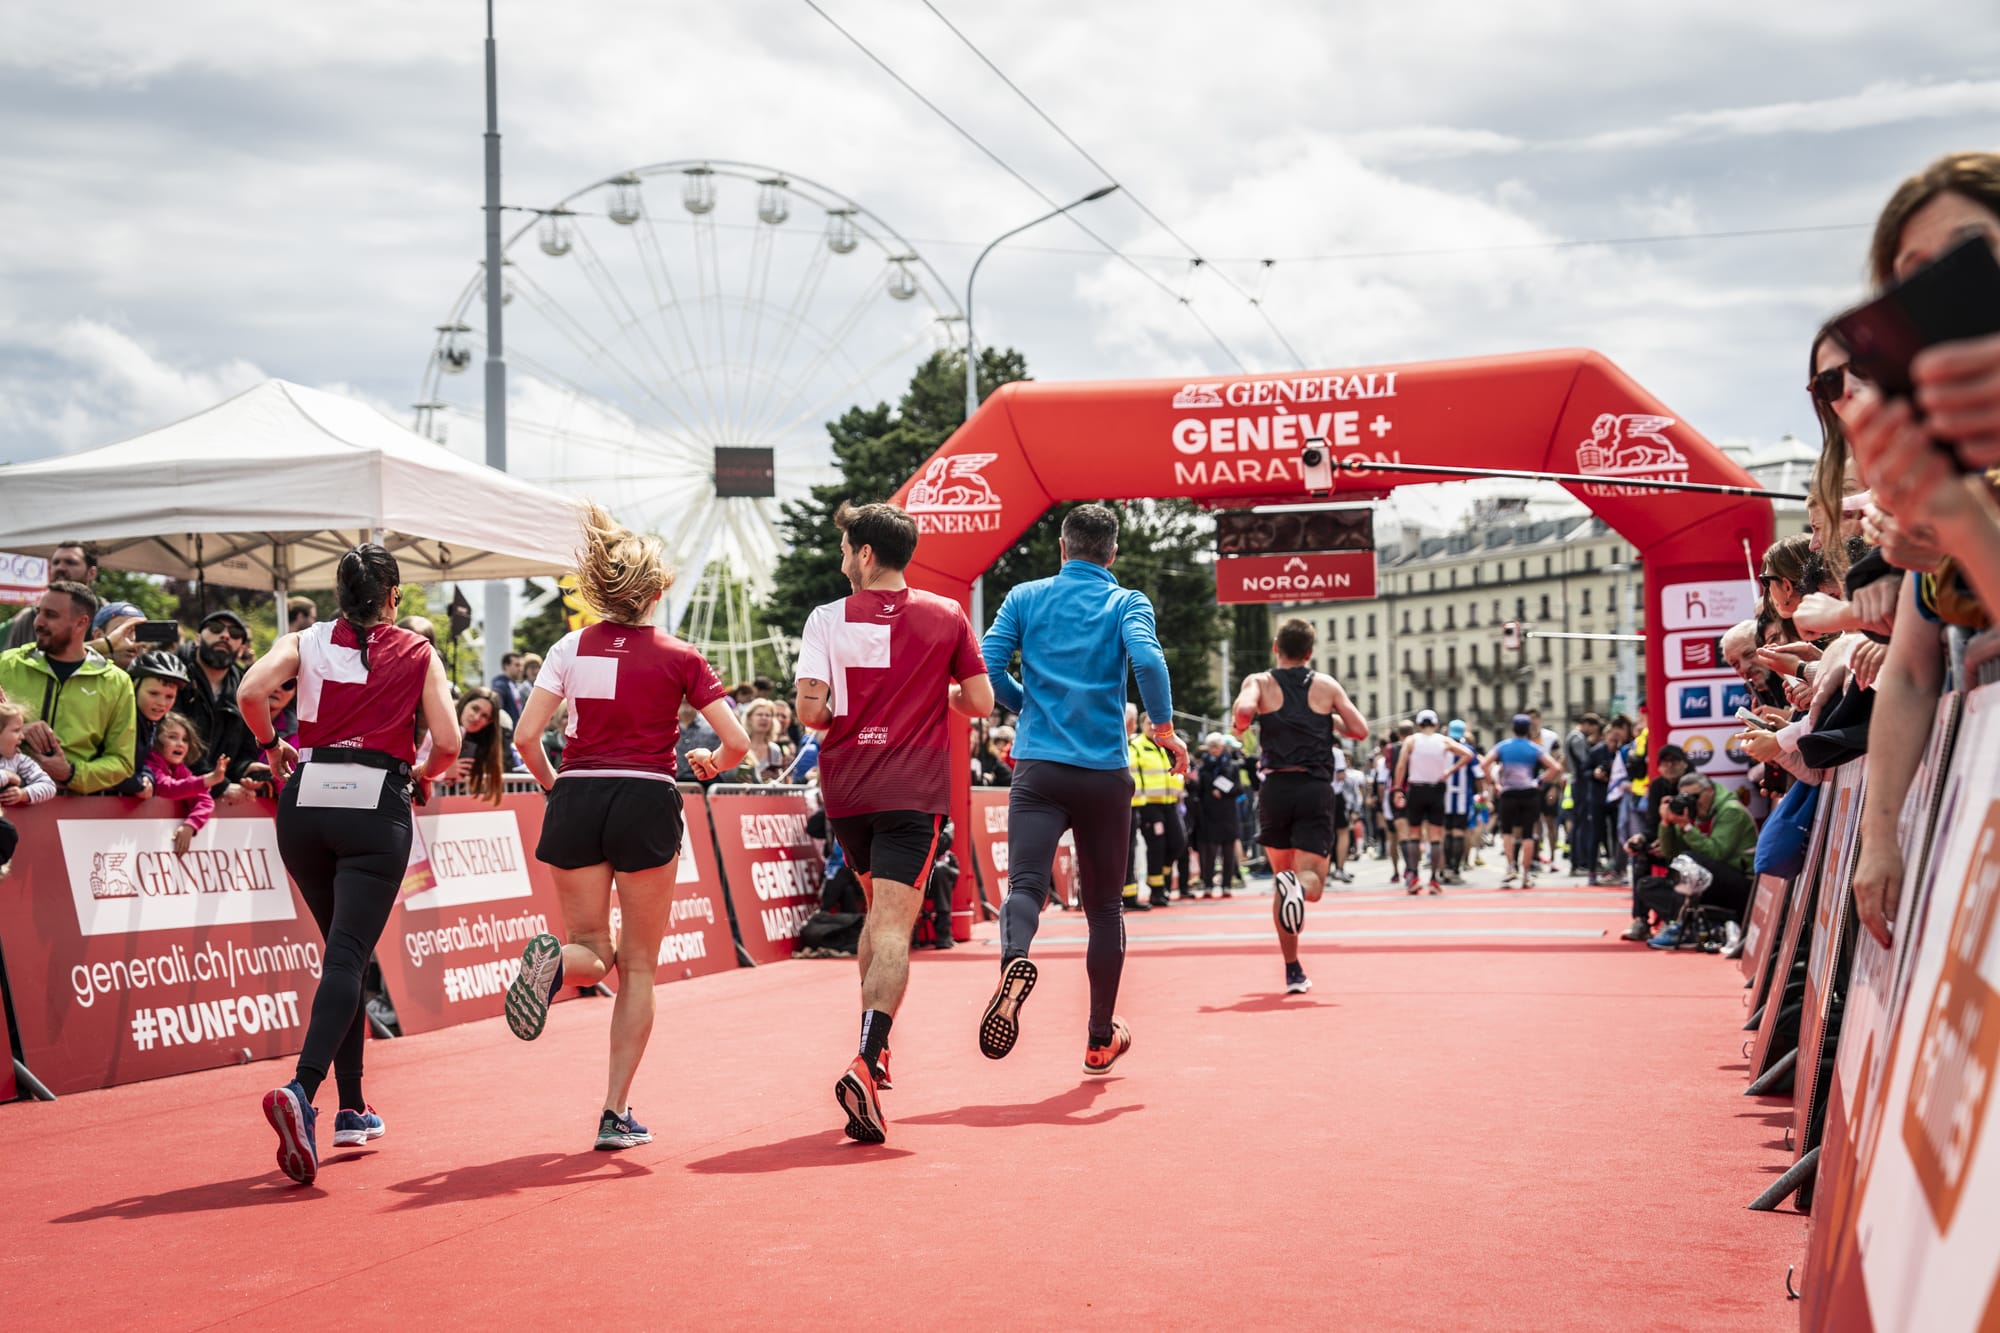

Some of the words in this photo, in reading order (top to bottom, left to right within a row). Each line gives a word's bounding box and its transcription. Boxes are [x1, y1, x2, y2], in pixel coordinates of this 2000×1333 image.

[1226, 372, 1398, 407] GENERALI
[1172, 406, 1361, 455] GENÈVE
[1174, 450, 1400, 485] MARATON
[912, 512, 1001, 534] ENERALI
[1242, 573, 1351, 591] NORQAIN
[135, 848, 276, 897] GENERALI
[431, 836, 518, 879] GENERALI
[751, 849, 814, 901] GENÈVE
[71, 936, 324, 1008] generali.ch/running
[443, 956, 522, 1003] #RUNFOR
[131, 990, 301, 1052] #RUNFORIT
